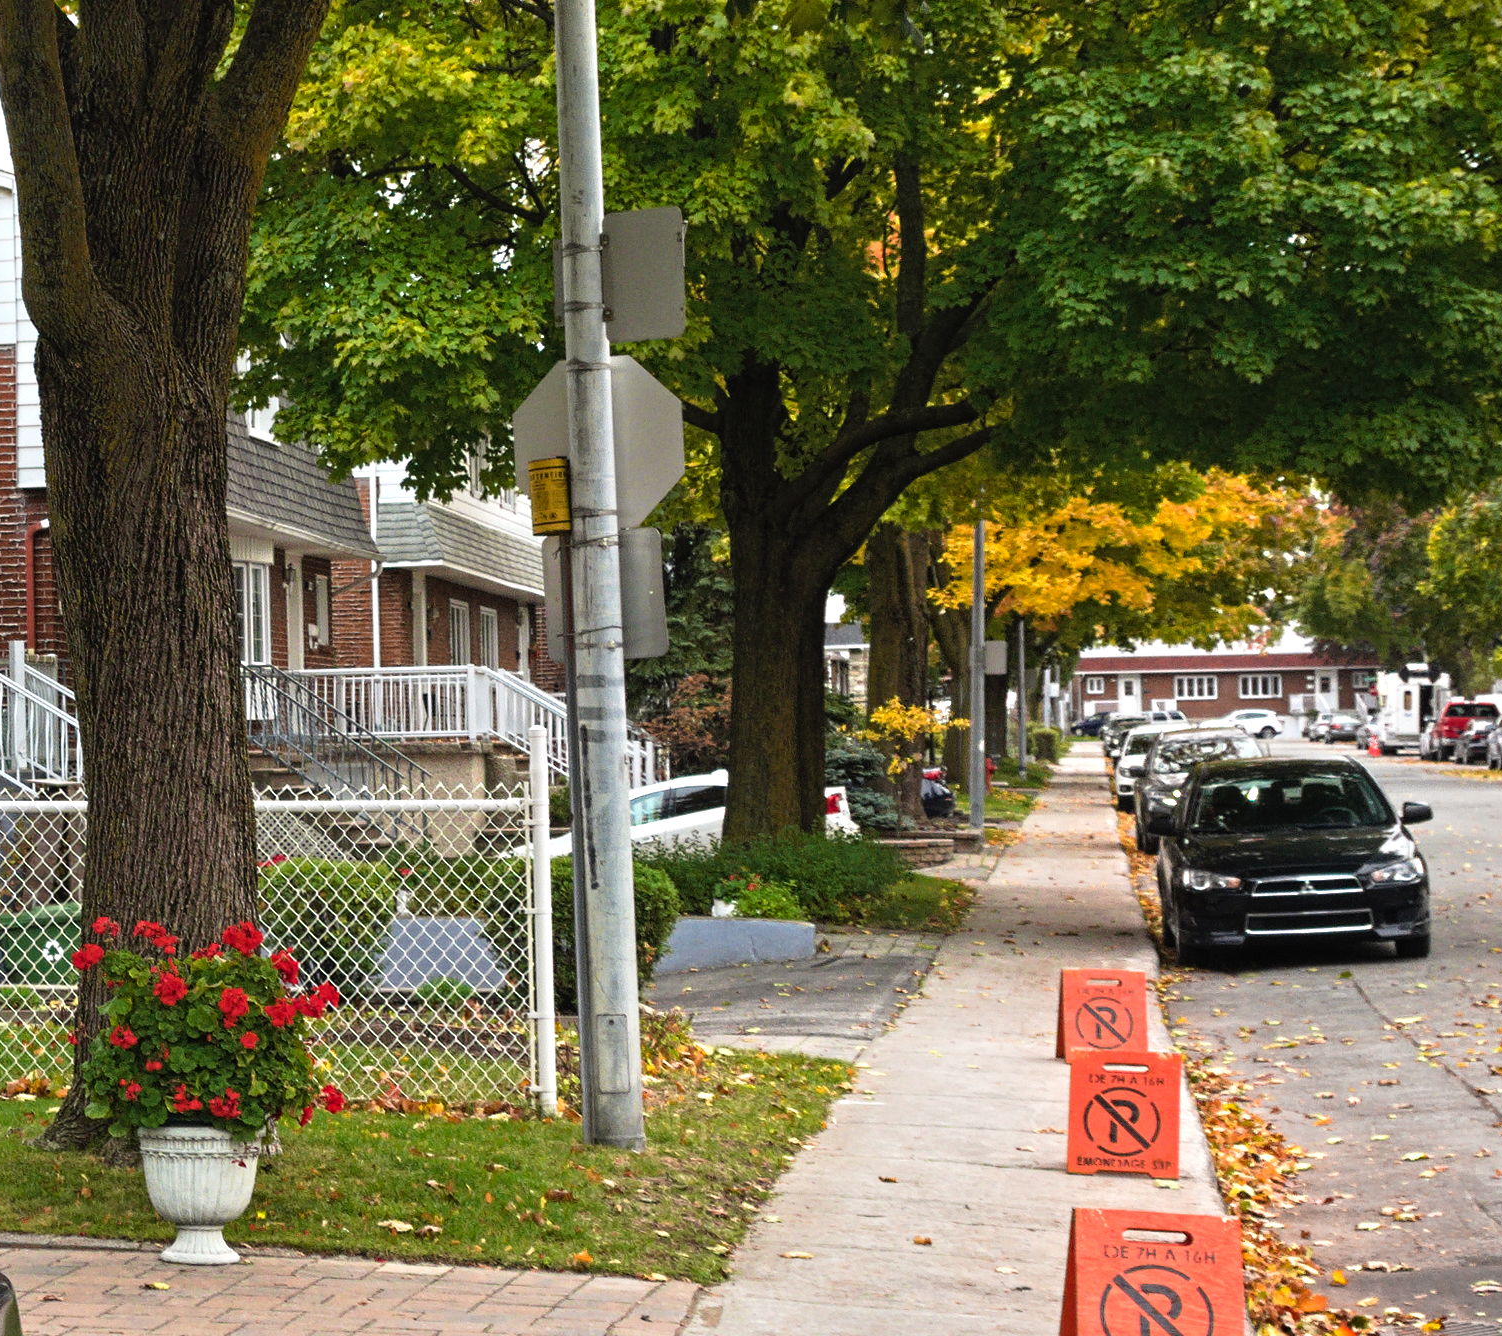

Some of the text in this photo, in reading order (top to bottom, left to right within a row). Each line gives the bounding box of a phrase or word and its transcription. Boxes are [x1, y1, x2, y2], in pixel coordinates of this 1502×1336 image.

[1103, 1245, 1216, 1264] DE 7H A 16H
